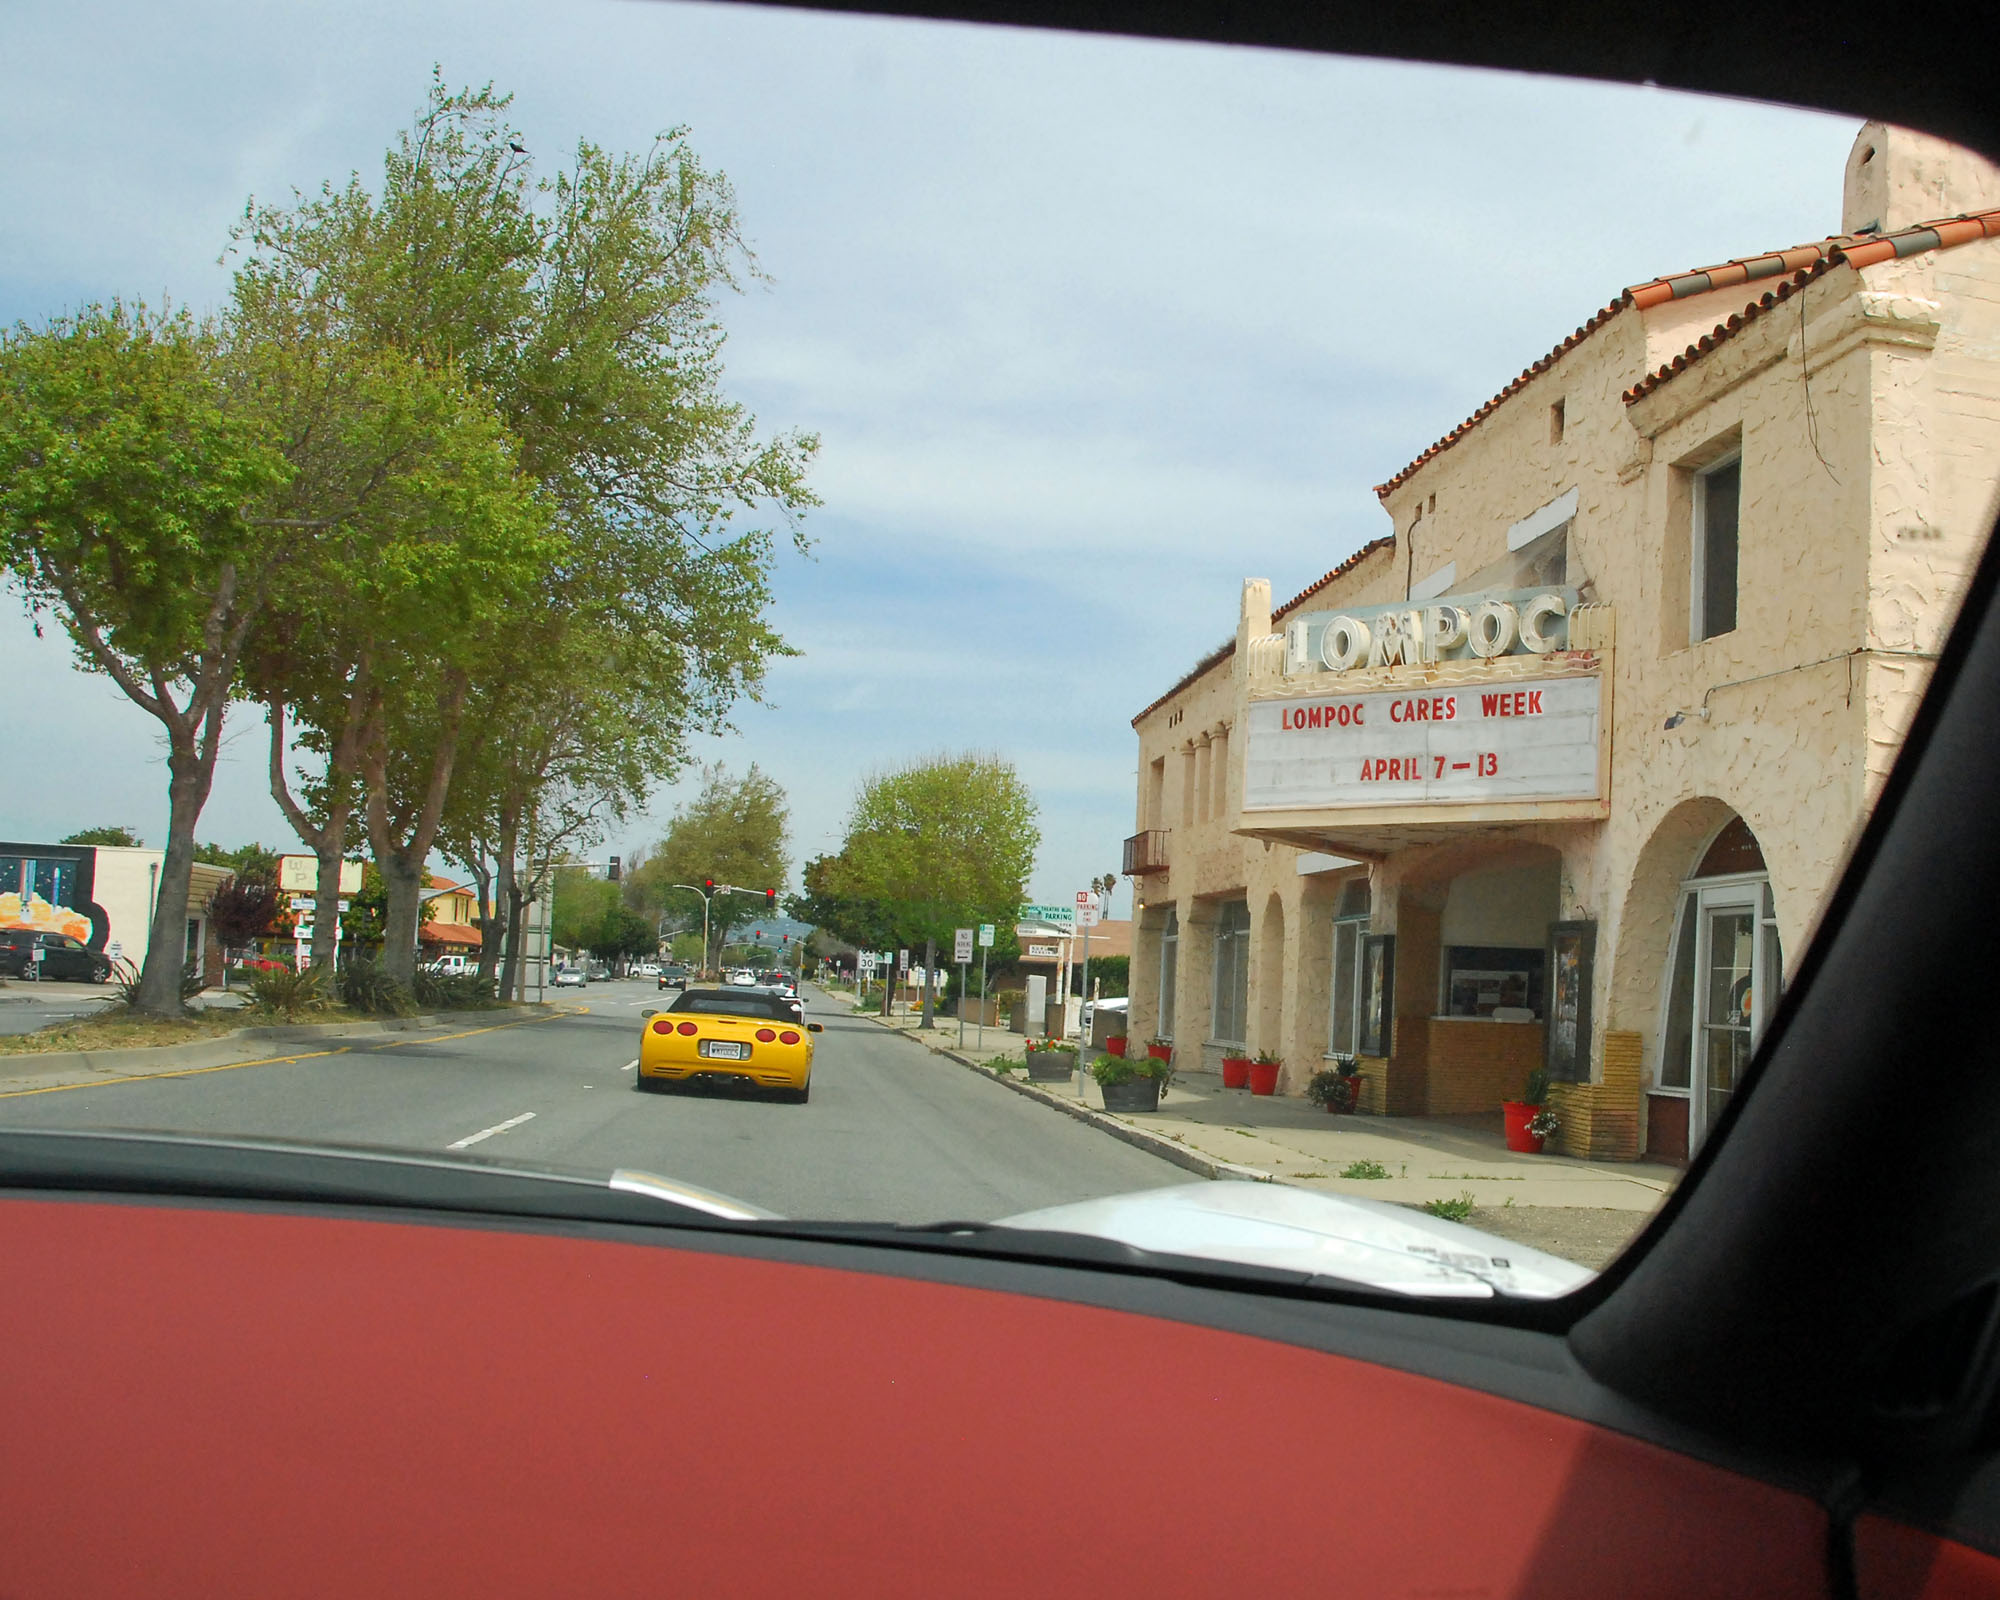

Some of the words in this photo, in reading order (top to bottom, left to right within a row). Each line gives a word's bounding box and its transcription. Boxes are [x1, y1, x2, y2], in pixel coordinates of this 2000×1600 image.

[1285, 593, 1570, 676] LOMPOC
[1282, 703, 1364, 731] LOMPOC
[1390, 696, 1457, 723] CARES
[1481, 690, 1543, 718] WEEK
[1360, 757, 1422, 781] APRIL
[1045, 912, 1073, 921] PARKING
[861, 959, 873, 968] 30
